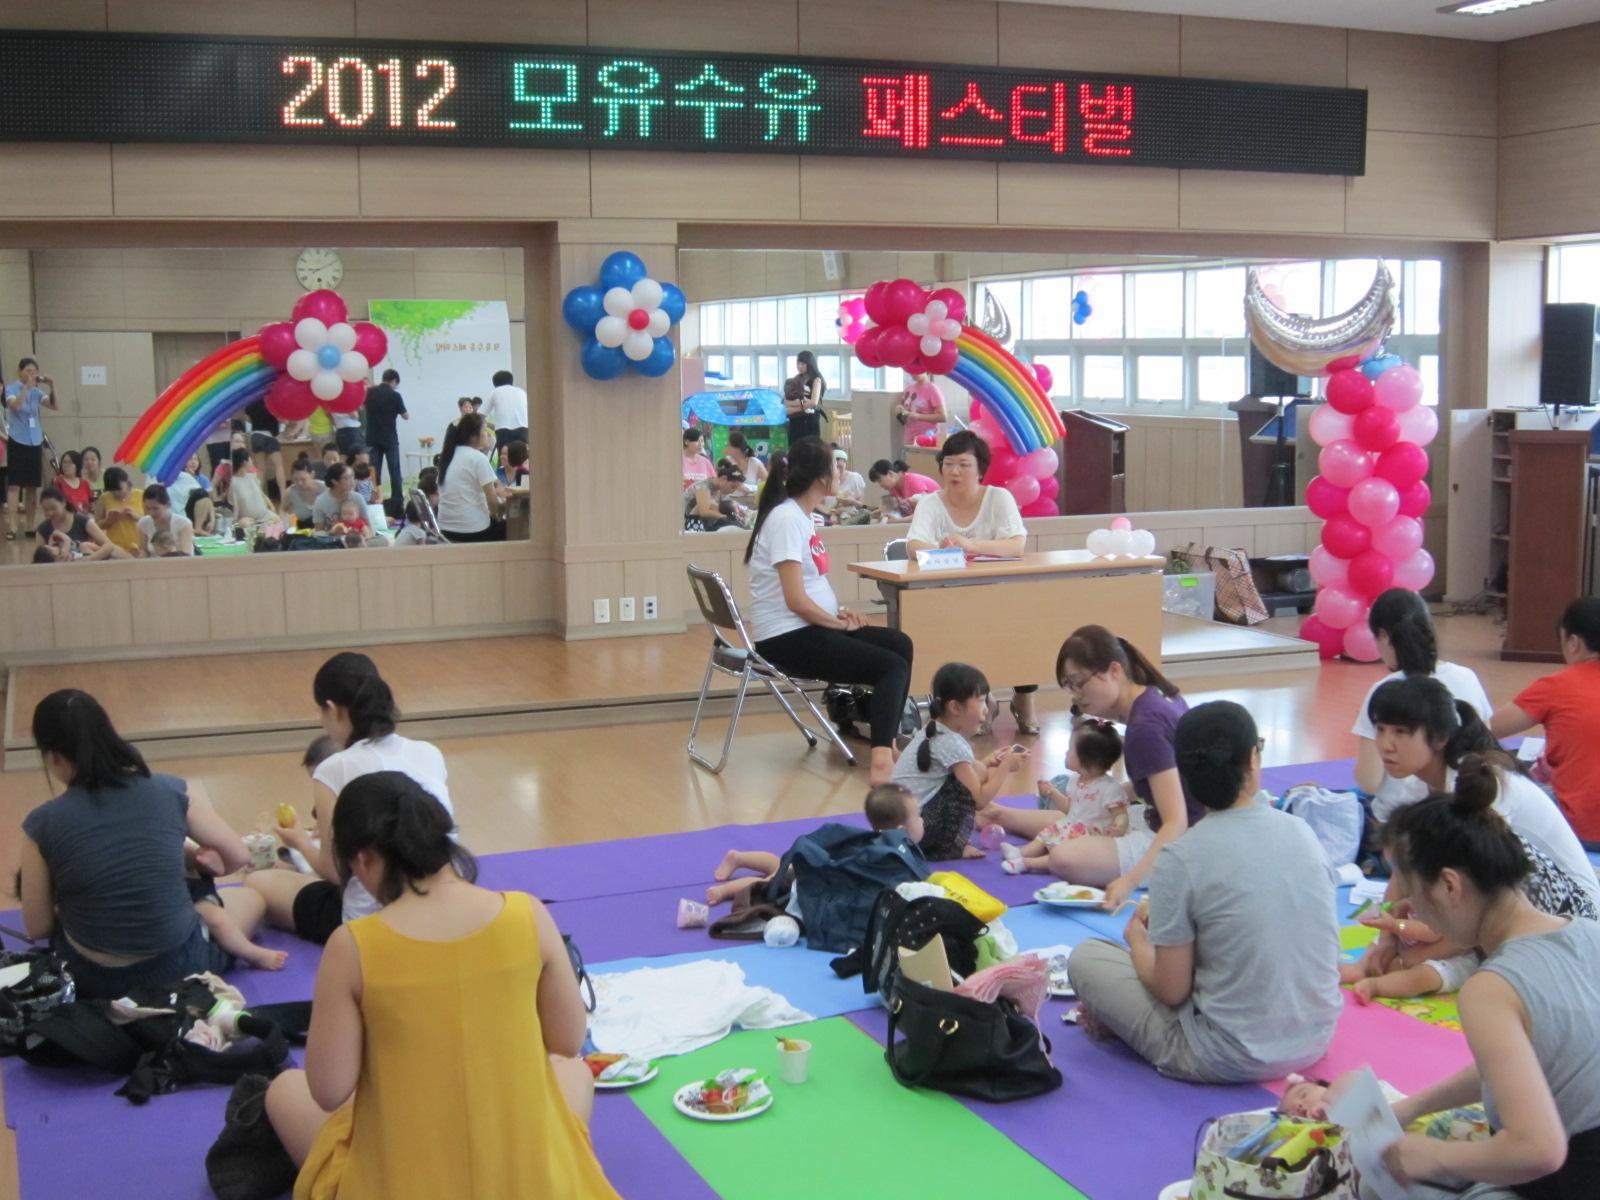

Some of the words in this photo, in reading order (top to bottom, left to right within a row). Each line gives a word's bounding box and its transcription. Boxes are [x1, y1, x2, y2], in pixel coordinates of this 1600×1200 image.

[282, 55, 457, 129] 2012
[509, 61, 822, 142] 모유수유
[862, 74, 1134, 156] 페스티벌
